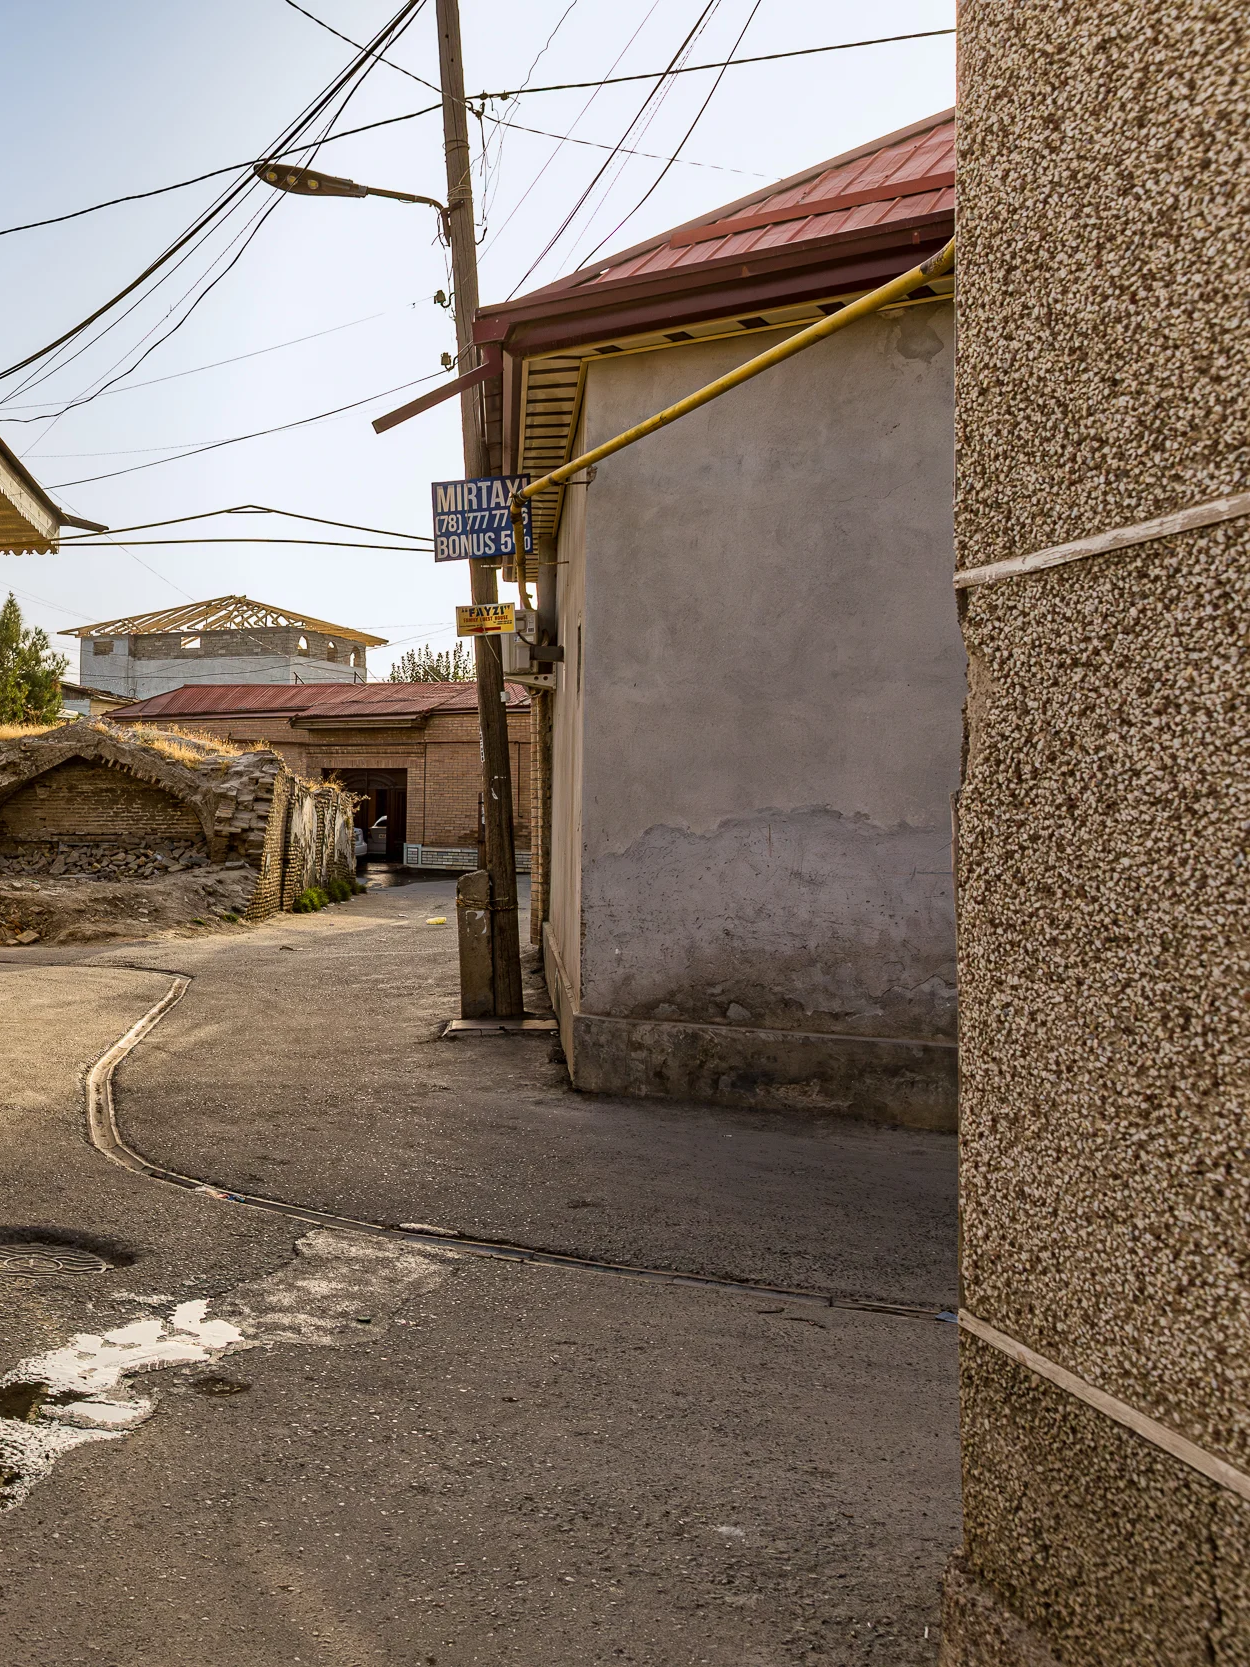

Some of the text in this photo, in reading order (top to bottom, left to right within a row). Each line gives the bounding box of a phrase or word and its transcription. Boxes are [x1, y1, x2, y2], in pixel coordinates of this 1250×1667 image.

[435, 513, 462, 536] (78)
[465, 511, 489, 531] 777
[491, 509, 508, 528] 77
[436, 532, 496, 559] BONUS
